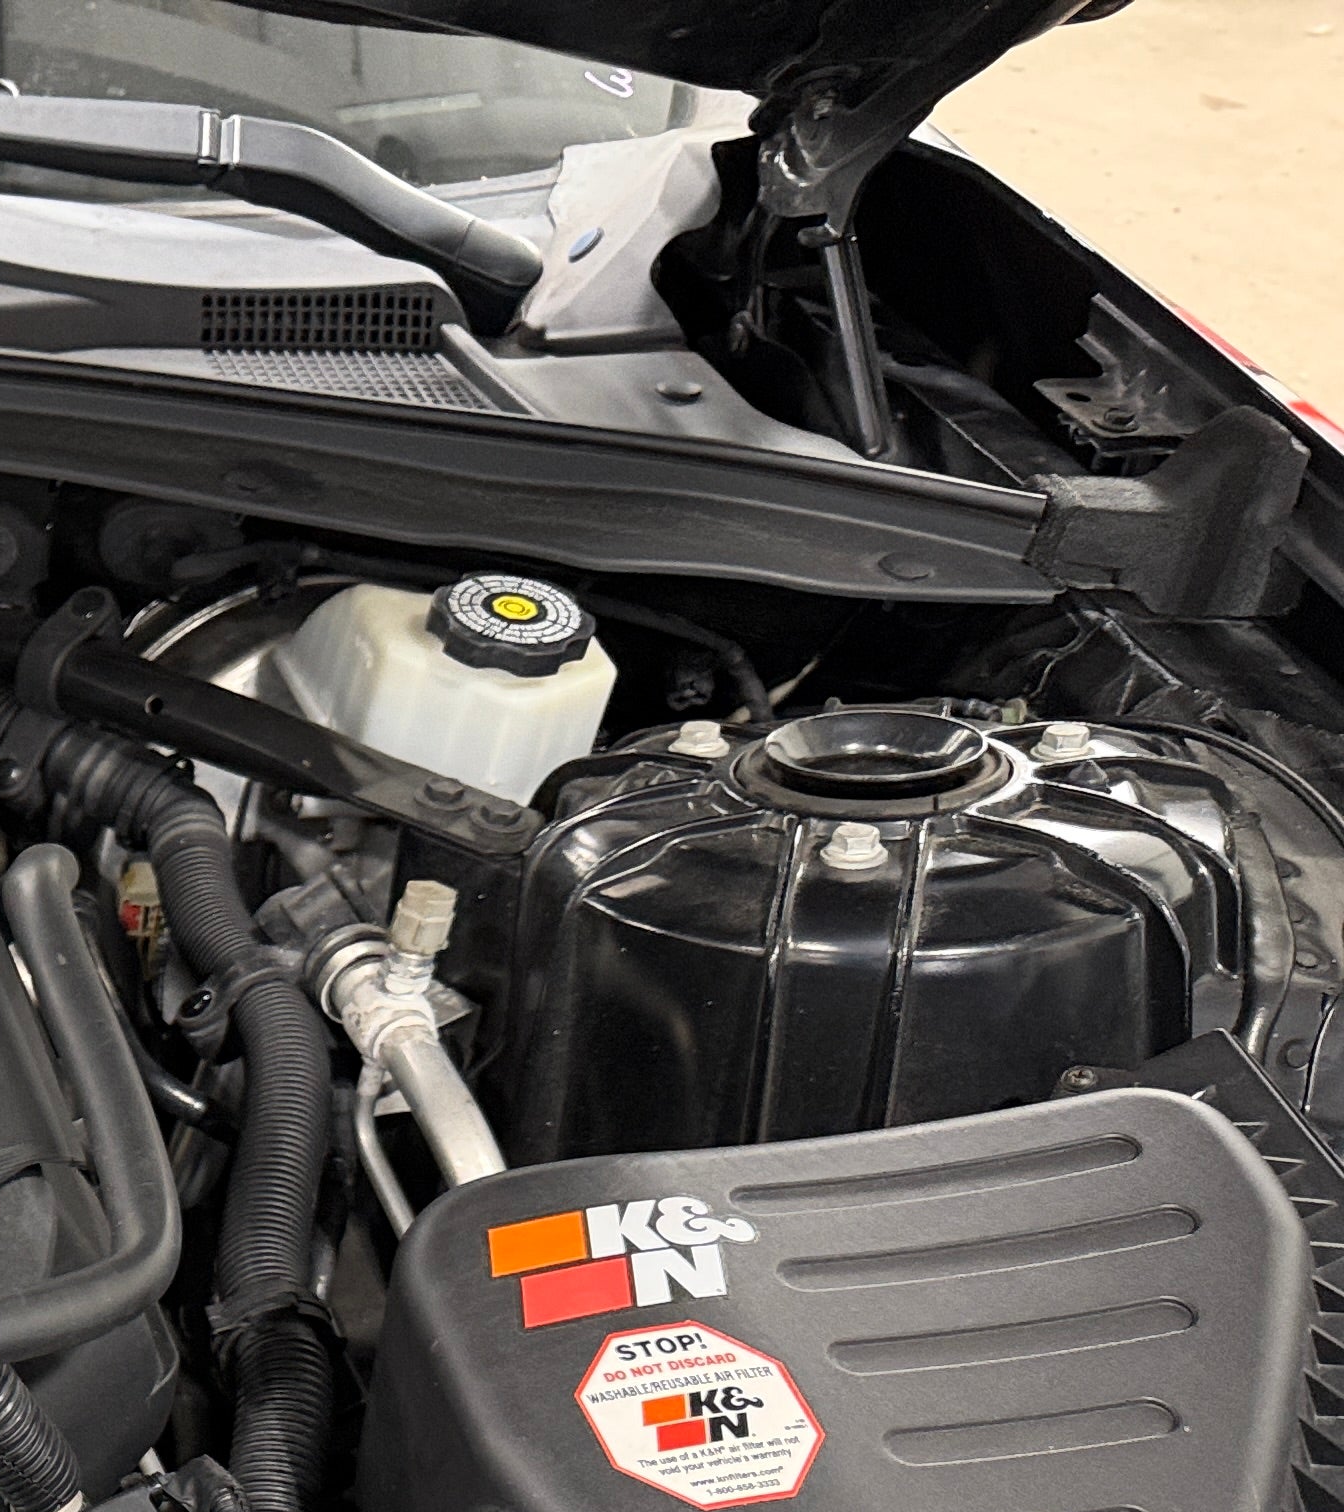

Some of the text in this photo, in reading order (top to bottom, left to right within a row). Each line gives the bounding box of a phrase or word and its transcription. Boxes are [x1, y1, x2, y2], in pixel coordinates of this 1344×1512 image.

[615, 1332, 708, 1361] STOP!
[603, 1352, 737, 1383] DO NOT DISCARD
[585, 1365, 774, 1404] WASHABLE/REUSABLE AIR FILTER
[638, 1458, 658, 1469] The
[659, 1456, 678, 1465] use
[679, 1452, 691, 1462] of
[728, 1444, 741, 1454] air
[742, 1440, 765, 1451] filter
[766, 1437, 783, 1448] will
[784, 1435, 801, 1445] not
[658, 1448, 792, 1476] void your vehicle's warranty
